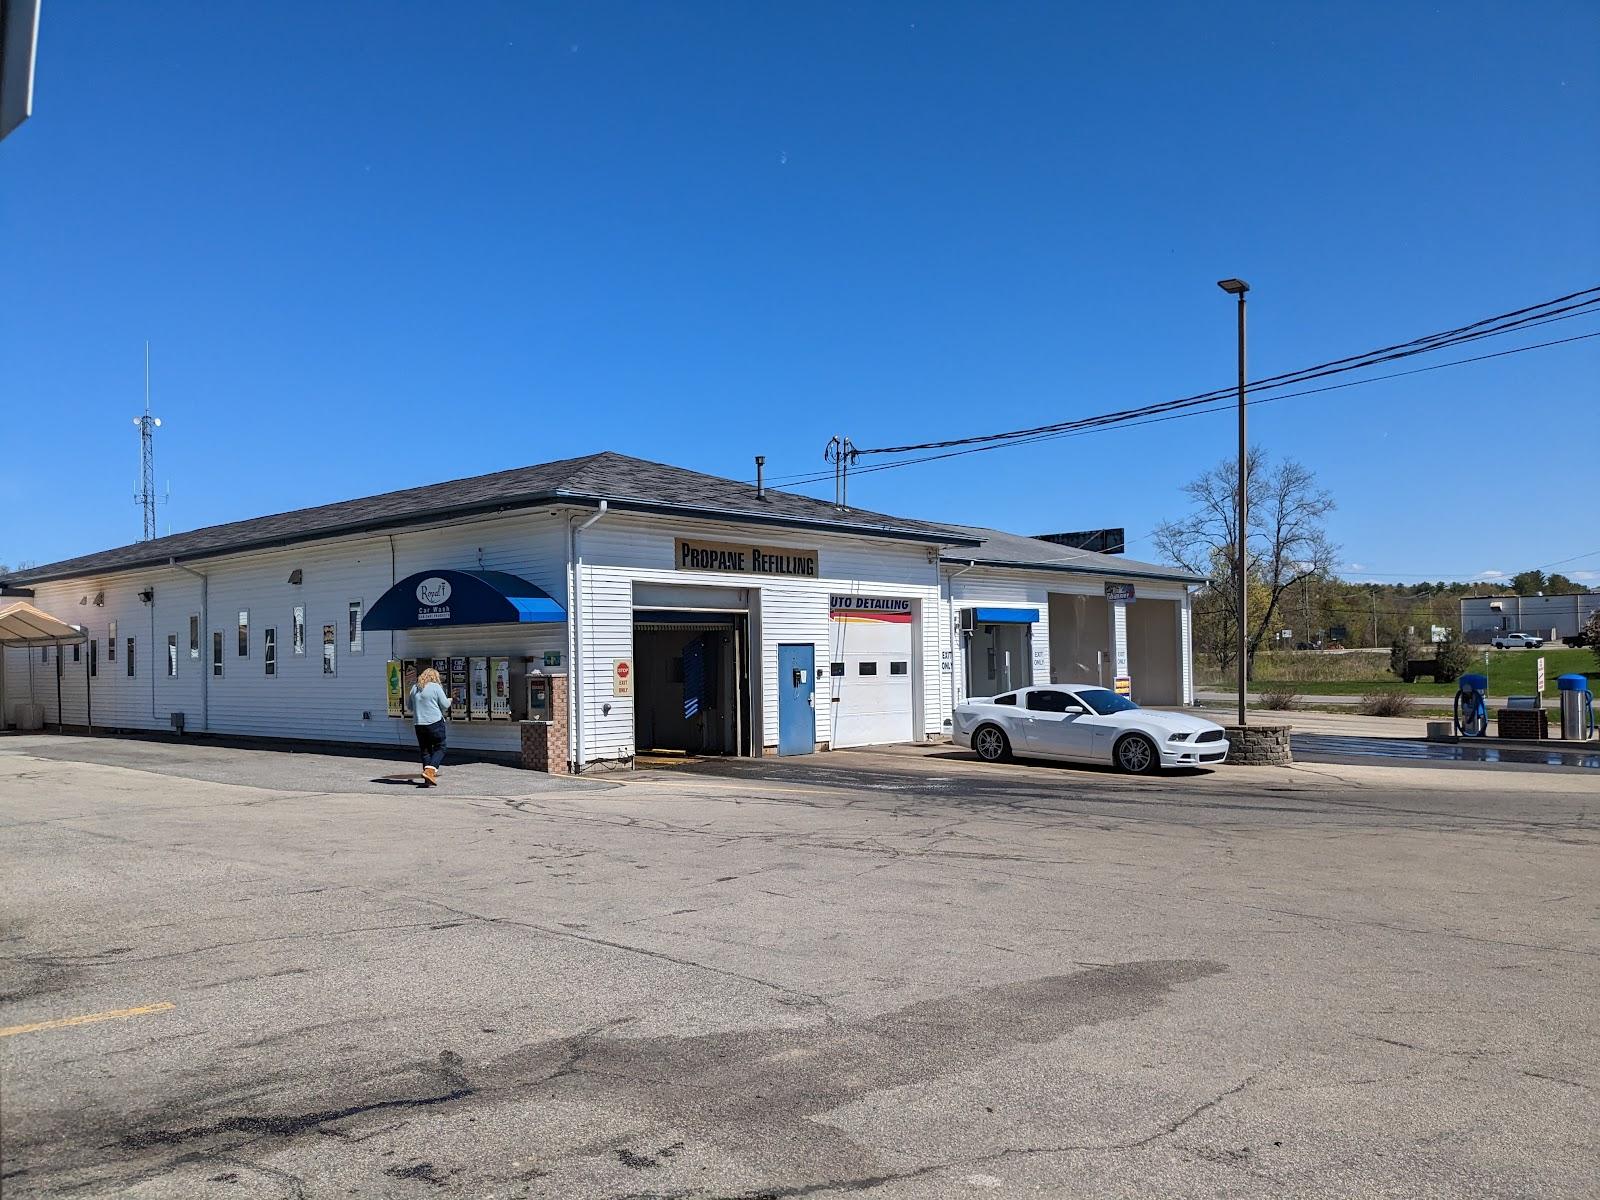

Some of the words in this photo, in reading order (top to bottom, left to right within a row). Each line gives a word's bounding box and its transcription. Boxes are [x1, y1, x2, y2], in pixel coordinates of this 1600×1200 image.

[682, 543, 745, 570] PROPANE
[752, 549, 813, 576] REFILLING
[420, 584, 441, 603] Royal
[831, 597, 852, 608] UTO
[856, 598, 909, 610] DETAILING
